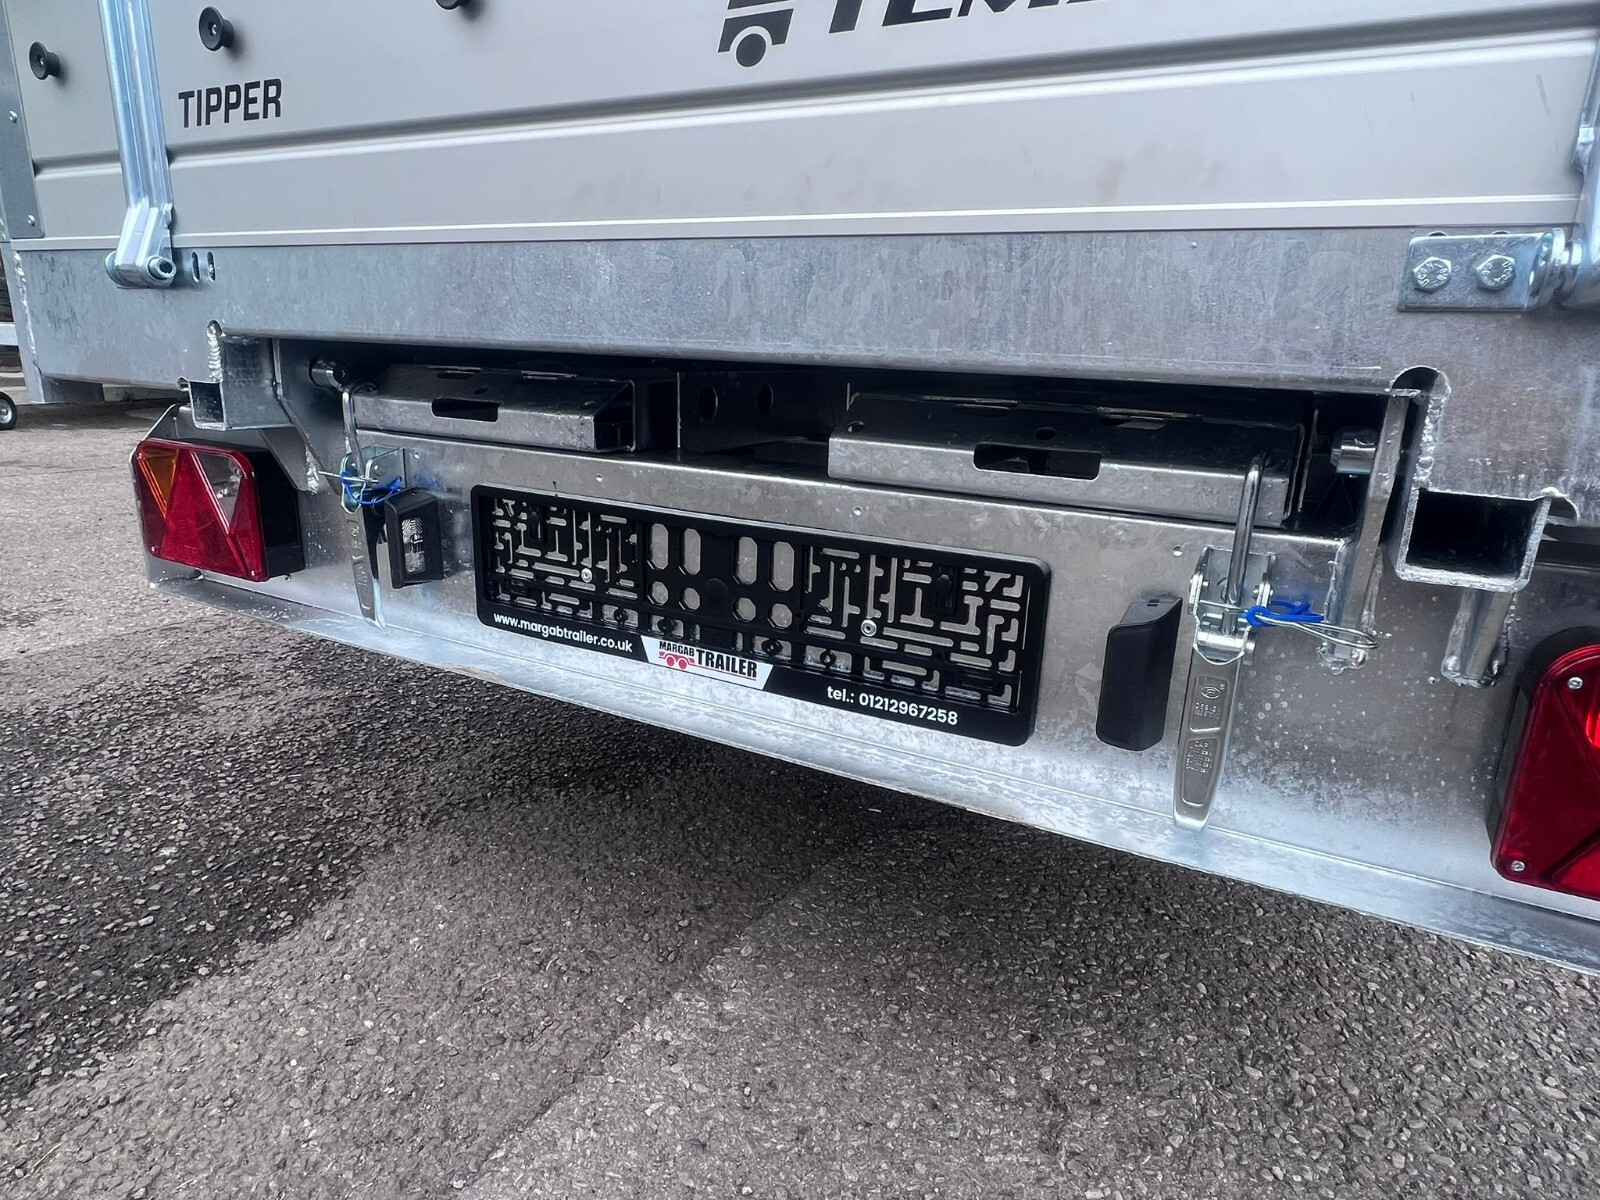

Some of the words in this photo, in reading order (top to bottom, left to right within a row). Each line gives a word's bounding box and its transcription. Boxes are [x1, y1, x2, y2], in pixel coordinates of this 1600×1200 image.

[178, 78, 282, 128] TIPPER
[493, 612, 633, 652] www.margabtrailer.co.uk
[659, 641, 695, 657] MARGAB
[696, 648, 758, 678] TRAILER
[827, 686, 855, 704] tel.:
[859, 693, 958, 725] 01212967258
